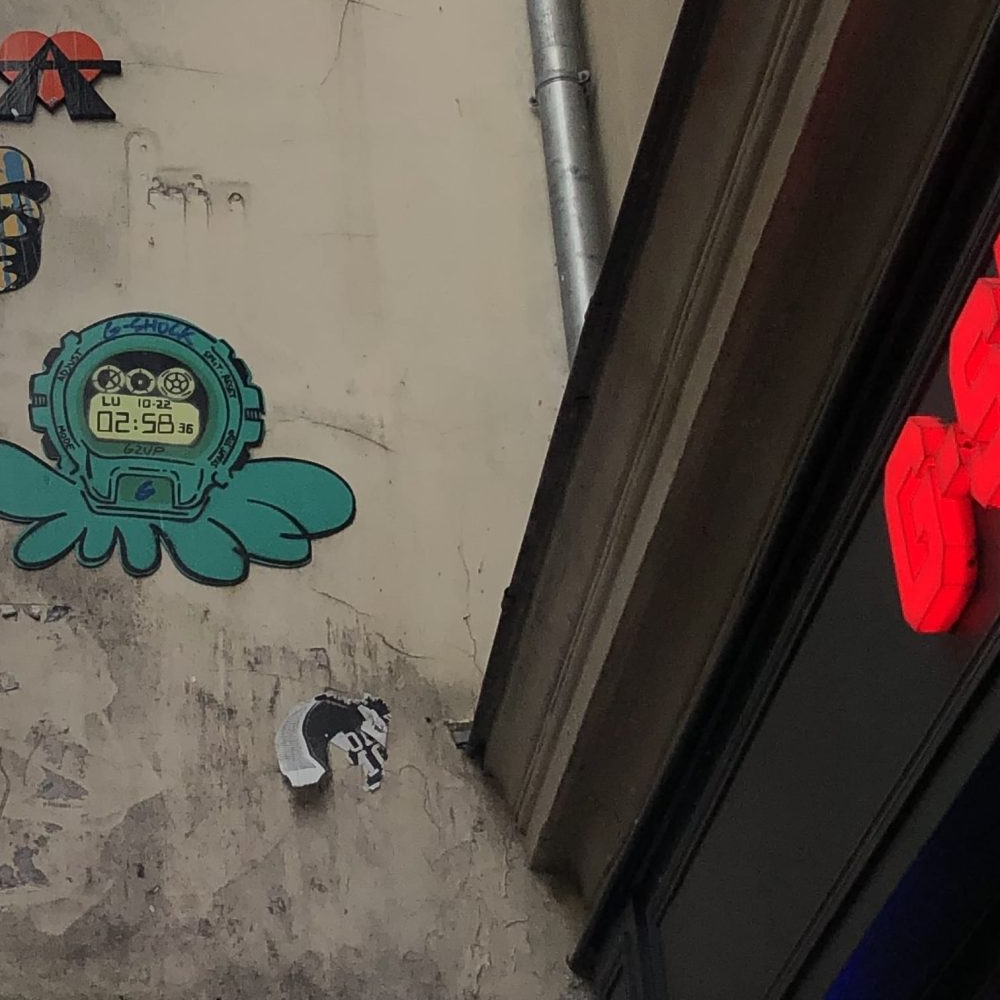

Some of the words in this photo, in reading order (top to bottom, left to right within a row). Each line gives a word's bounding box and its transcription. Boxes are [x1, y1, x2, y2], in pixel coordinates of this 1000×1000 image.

[103, 318, 195, 345] G-SHOCK
[57, 348, 82, 382] ADJUST
[102, 396, 121, 407] LU
[97, 411, 175, 434] 02:58
[178, 422, 194, 434] 36
[58, 425, 76, 451] MODE
